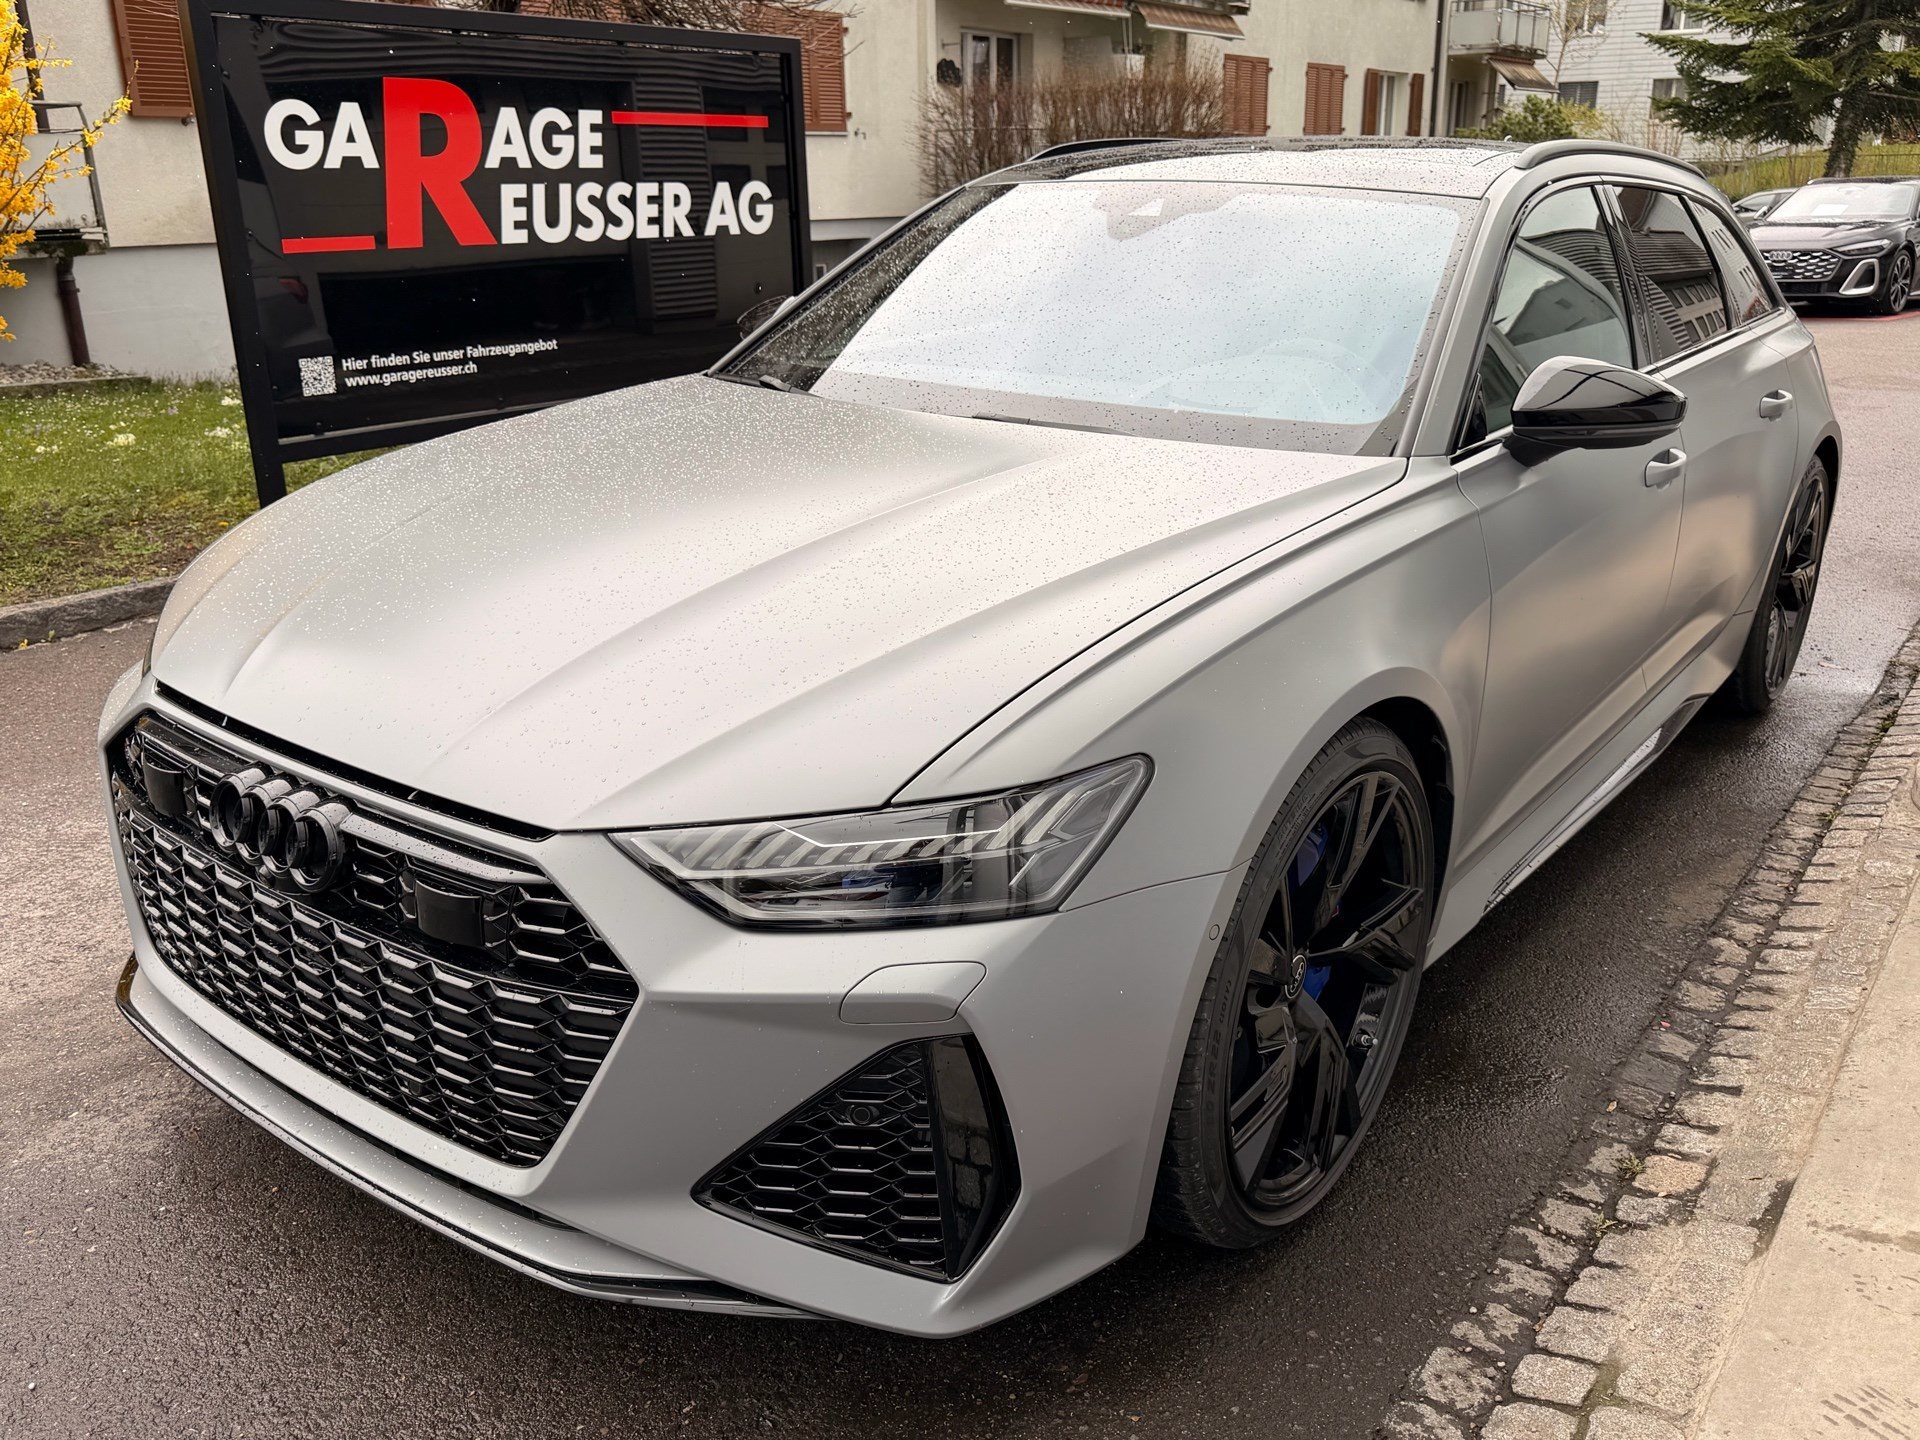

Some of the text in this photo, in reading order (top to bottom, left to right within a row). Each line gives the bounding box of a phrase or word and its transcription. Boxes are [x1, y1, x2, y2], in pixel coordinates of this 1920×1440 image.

[264, 77, 603, 248] GARAGE
[704, 181, 773, 236] AG
[341, 339, 559, 371] Hier finden Sie unser Fahrzeugangebot
[344, 361, 478, 387] www.garagereusser.ch
